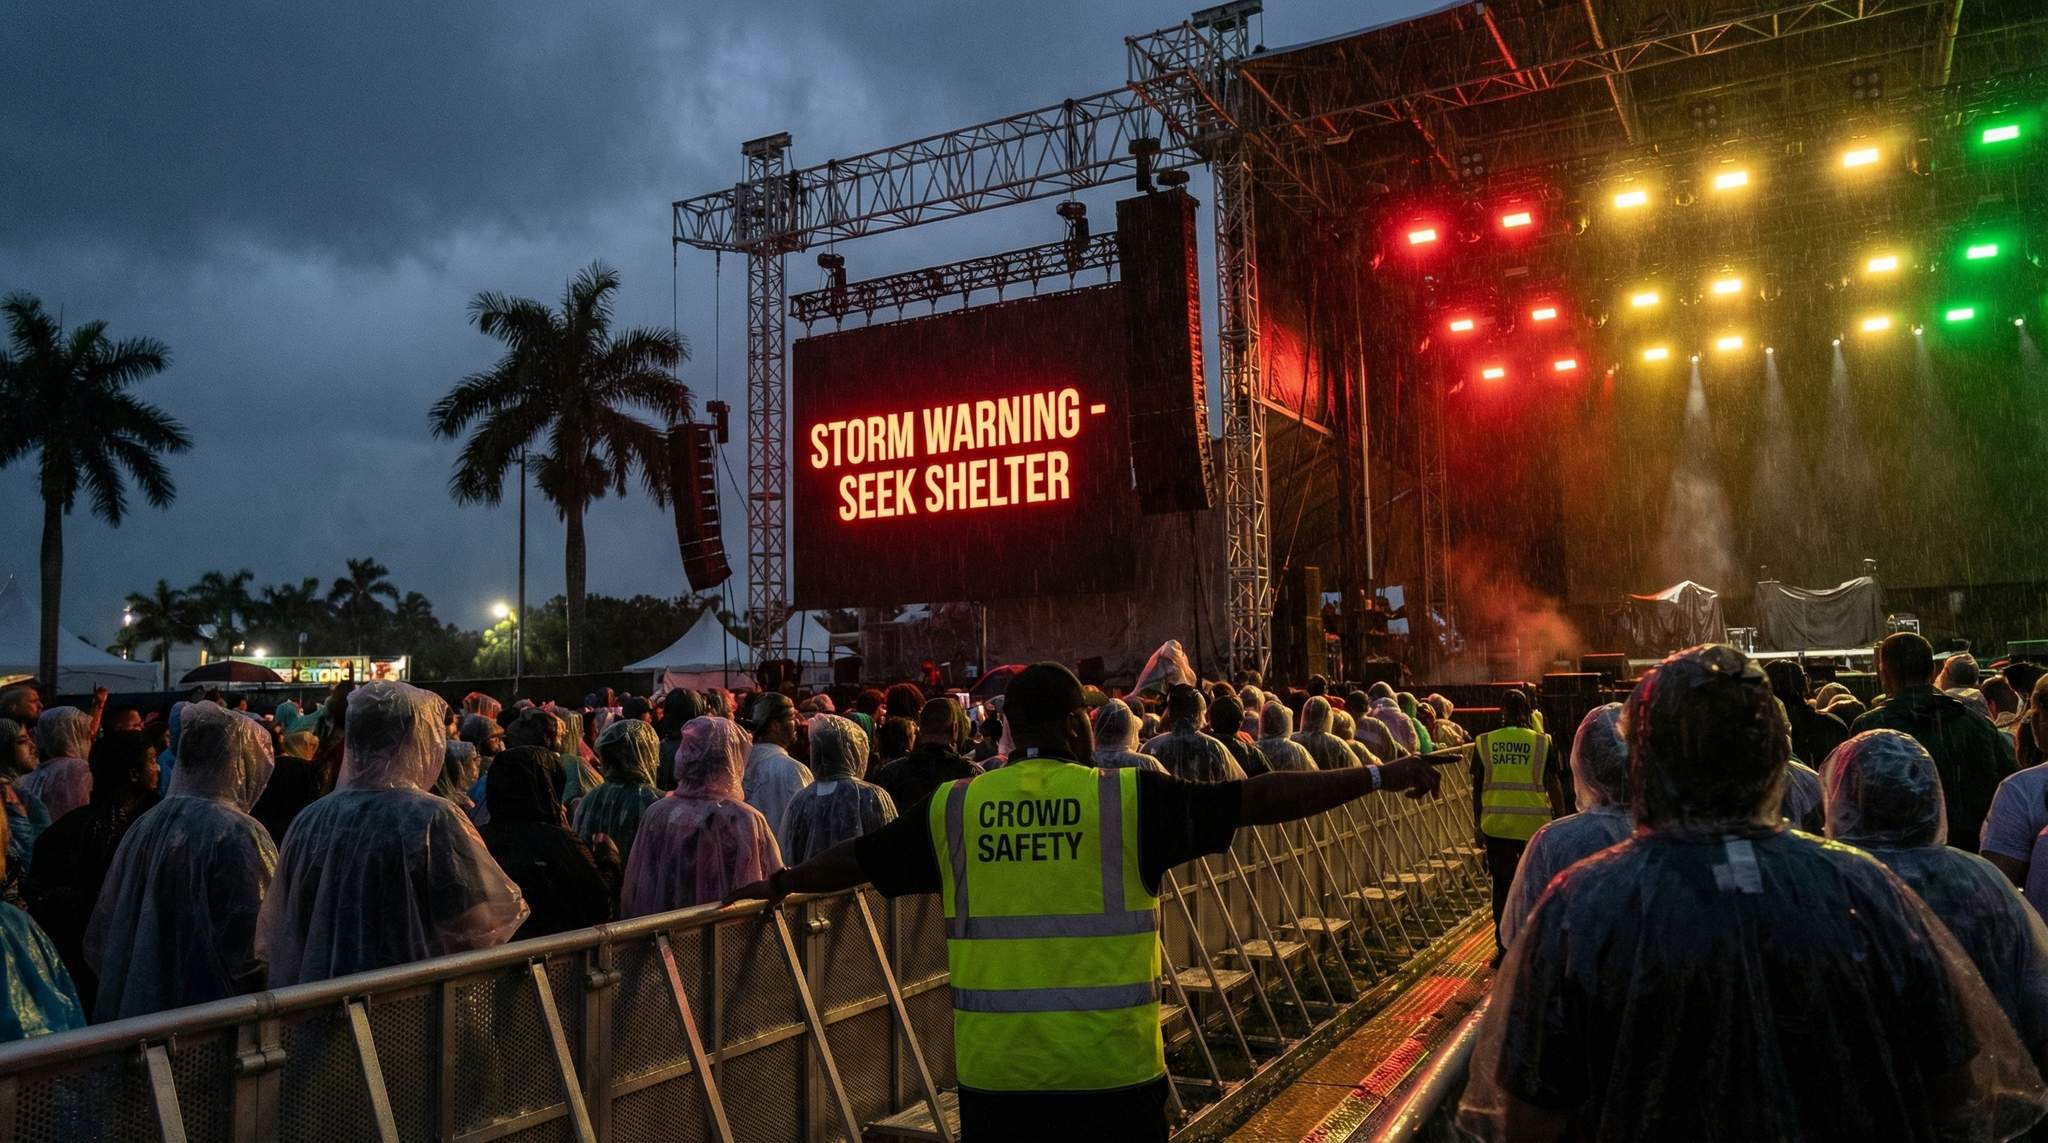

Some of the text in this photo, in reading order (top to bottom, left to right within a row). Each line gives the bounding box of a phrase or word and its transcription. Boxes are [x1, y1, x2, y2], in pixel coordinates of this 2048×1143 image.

[811, 411, 914, 469] STORM
[923, 388, 1080, 455] WARNING
[839, 450, 1070, 521] SEEK SHELTER
[1492, 742, 1531, 753] CROWD
[1492, 754, 1531, 765] SAFETY
[979, 799, 1081, 828] CROWD
[978, 831, 1083, 862] SAFETY
